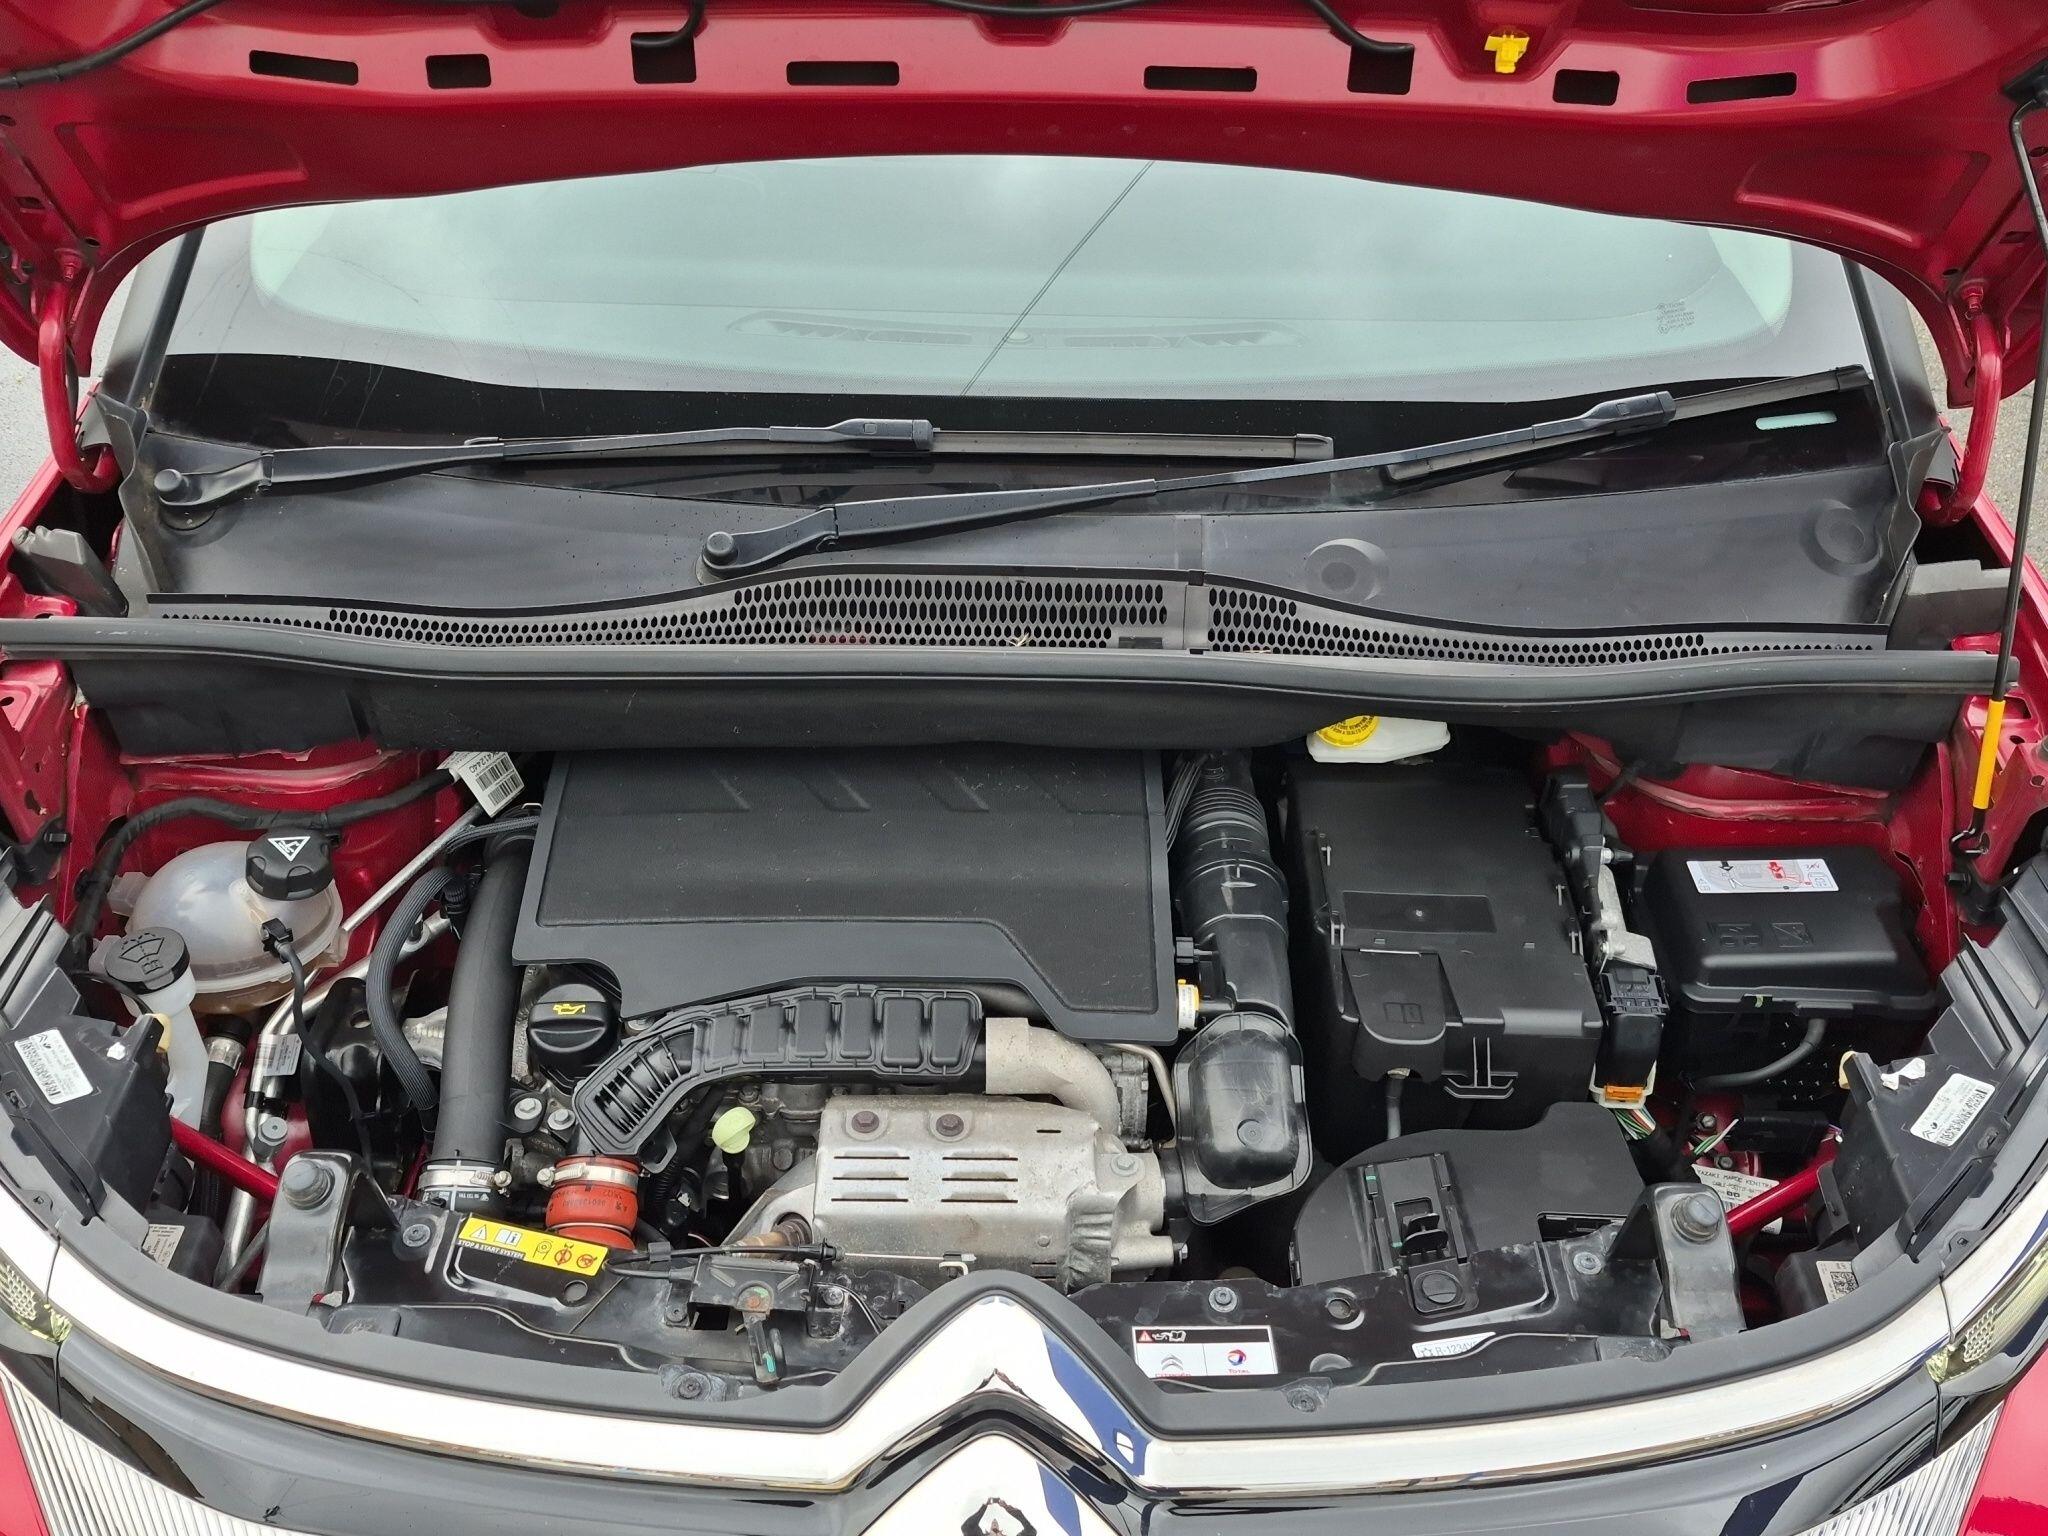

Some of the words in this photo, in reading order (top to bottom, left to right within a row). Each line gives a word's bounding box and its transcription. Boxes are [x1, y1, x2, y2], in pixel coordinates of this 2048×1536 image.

[458, 1240, 476, 1248] STOP
[480, 1243, 500, 1253] START
[500, 1247, 525, 1259] SYSTEM
